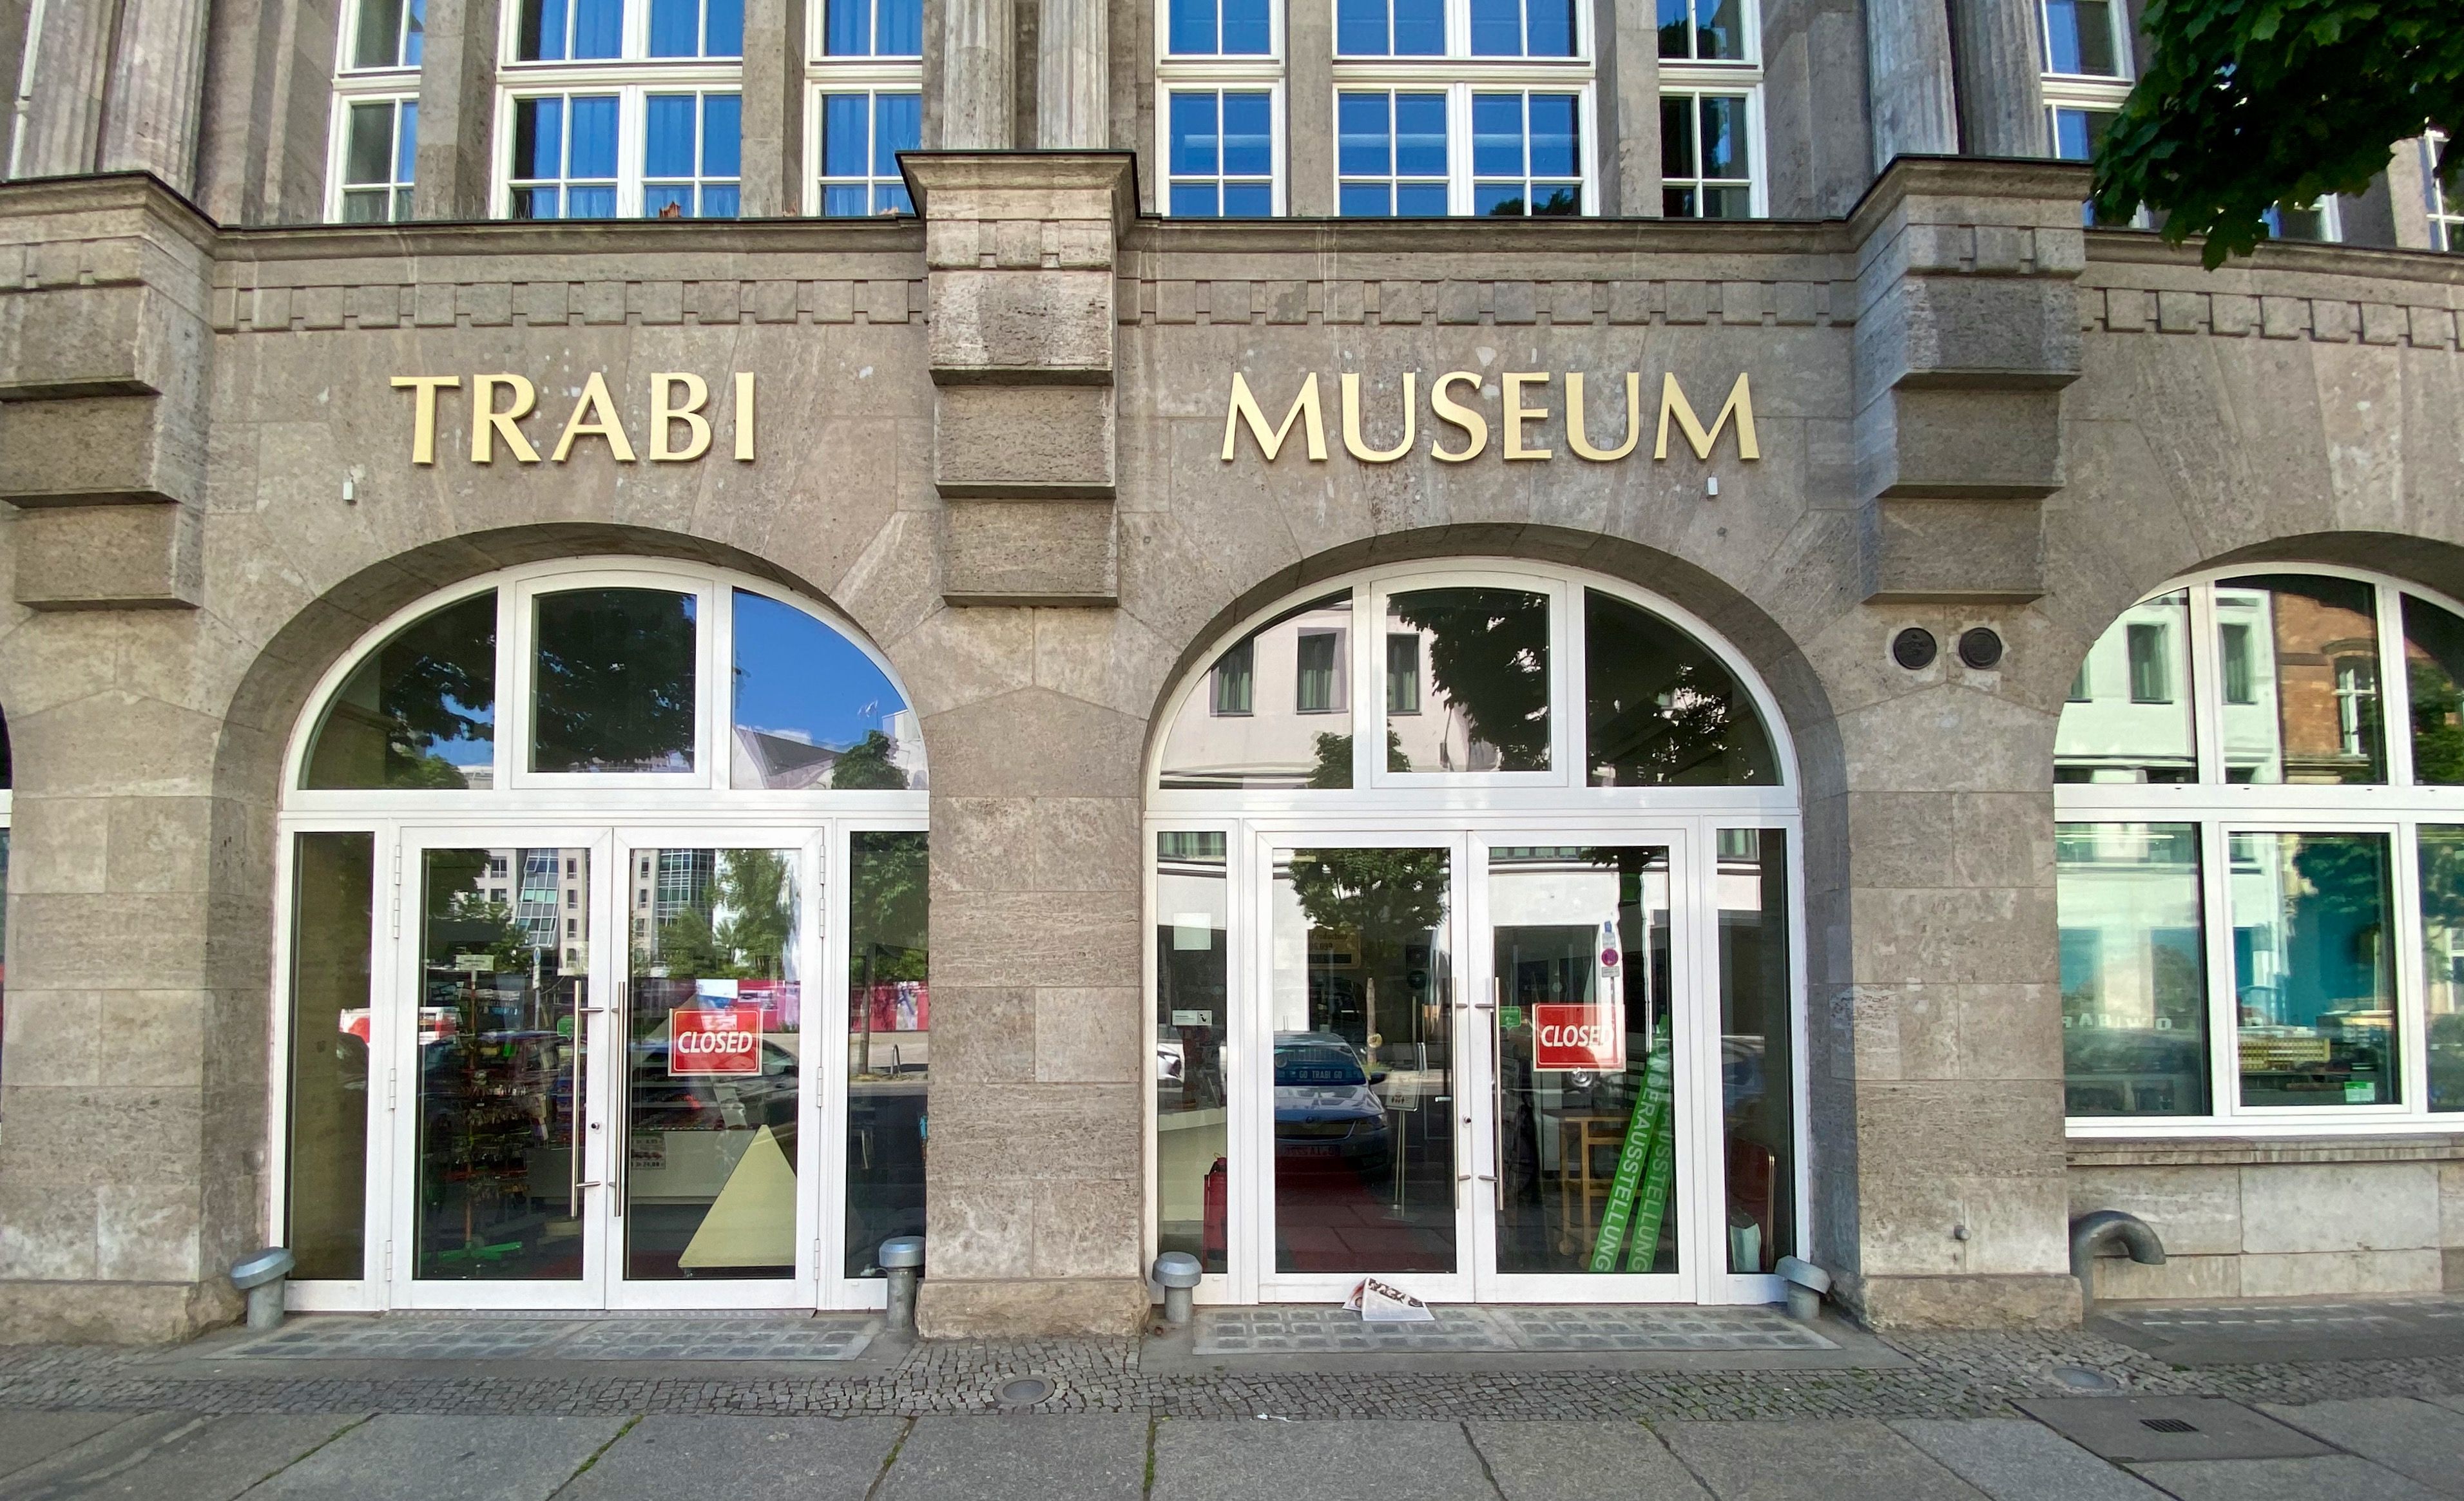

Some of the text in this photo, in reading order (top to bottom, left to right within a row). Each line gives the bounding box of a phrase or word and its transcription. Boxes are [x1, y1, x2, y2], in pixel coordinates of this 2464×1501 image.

[390, 371, 1760, 464] TRABI MUSEUM
[678, 1031, 753, 1054] CLOSED
[1541, 1024, 1614, 1047] CLOSED
[1299, 1070, 1343, 1079] GO TRABI GO
